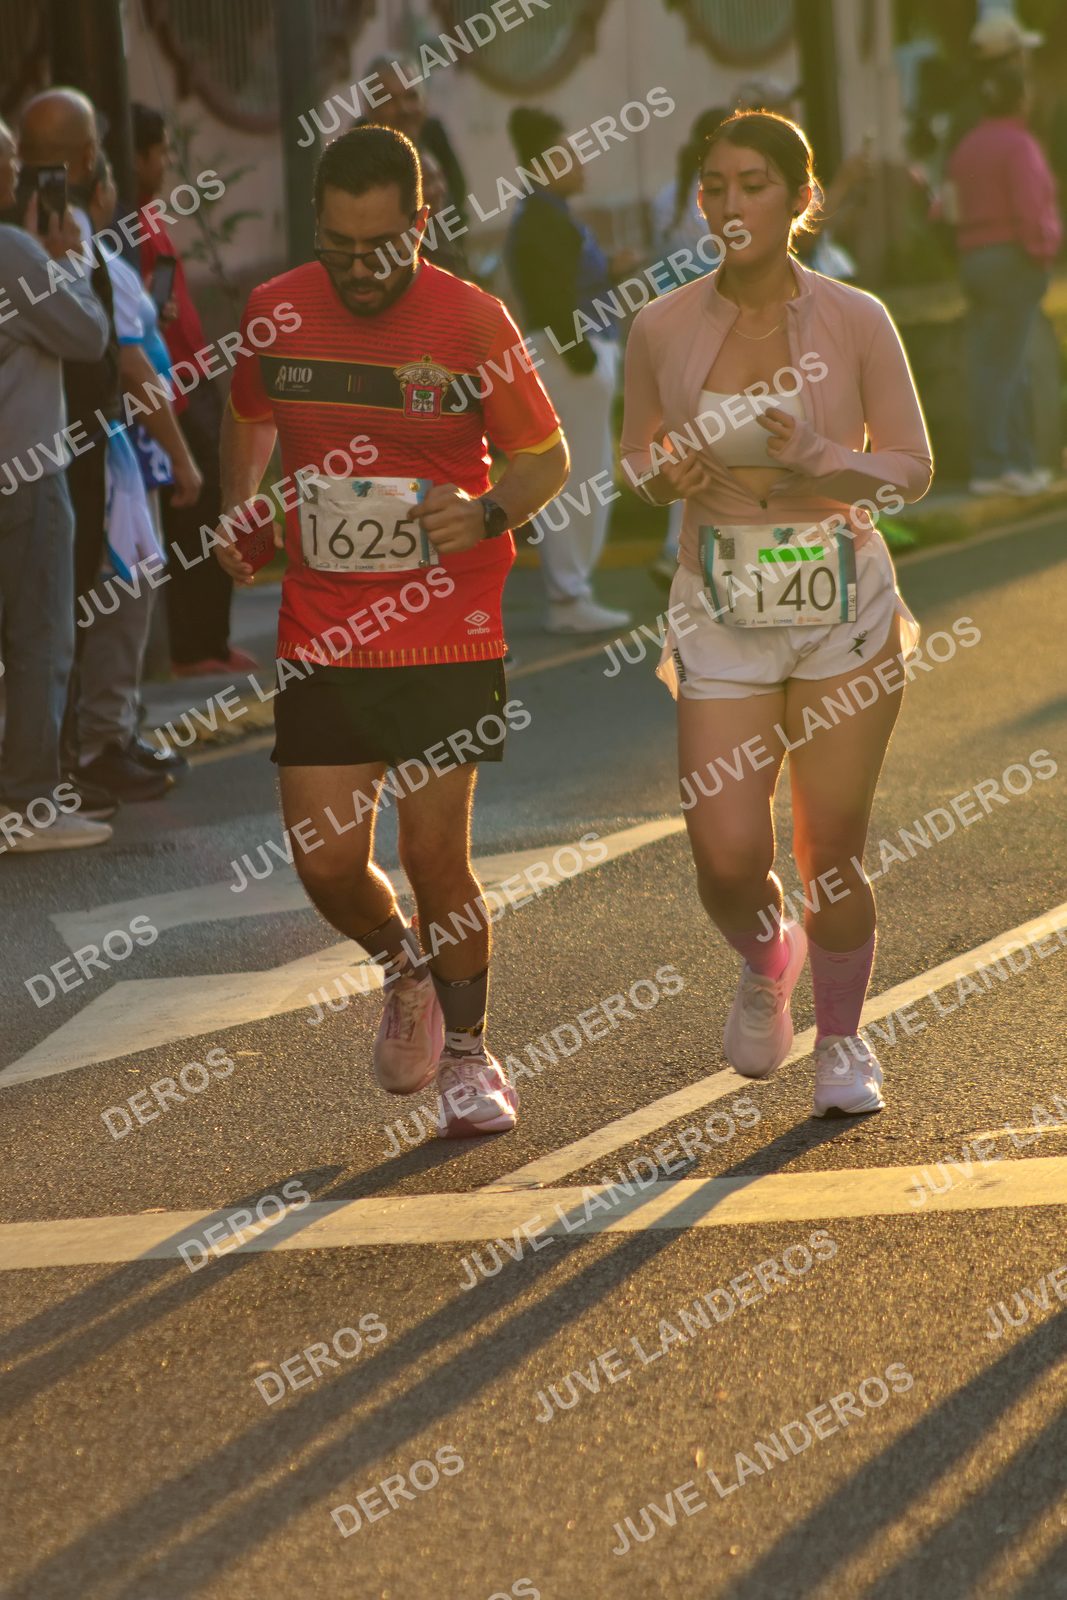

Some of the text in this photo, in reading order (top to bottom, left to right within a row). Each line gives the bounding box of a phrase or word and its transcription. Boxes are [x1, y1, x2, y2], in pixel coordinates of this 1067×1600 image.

[308, 513, 417, 560] 1625
[721, 566, 837, 614] 1140
[467, 627, 490, 635] umbro
